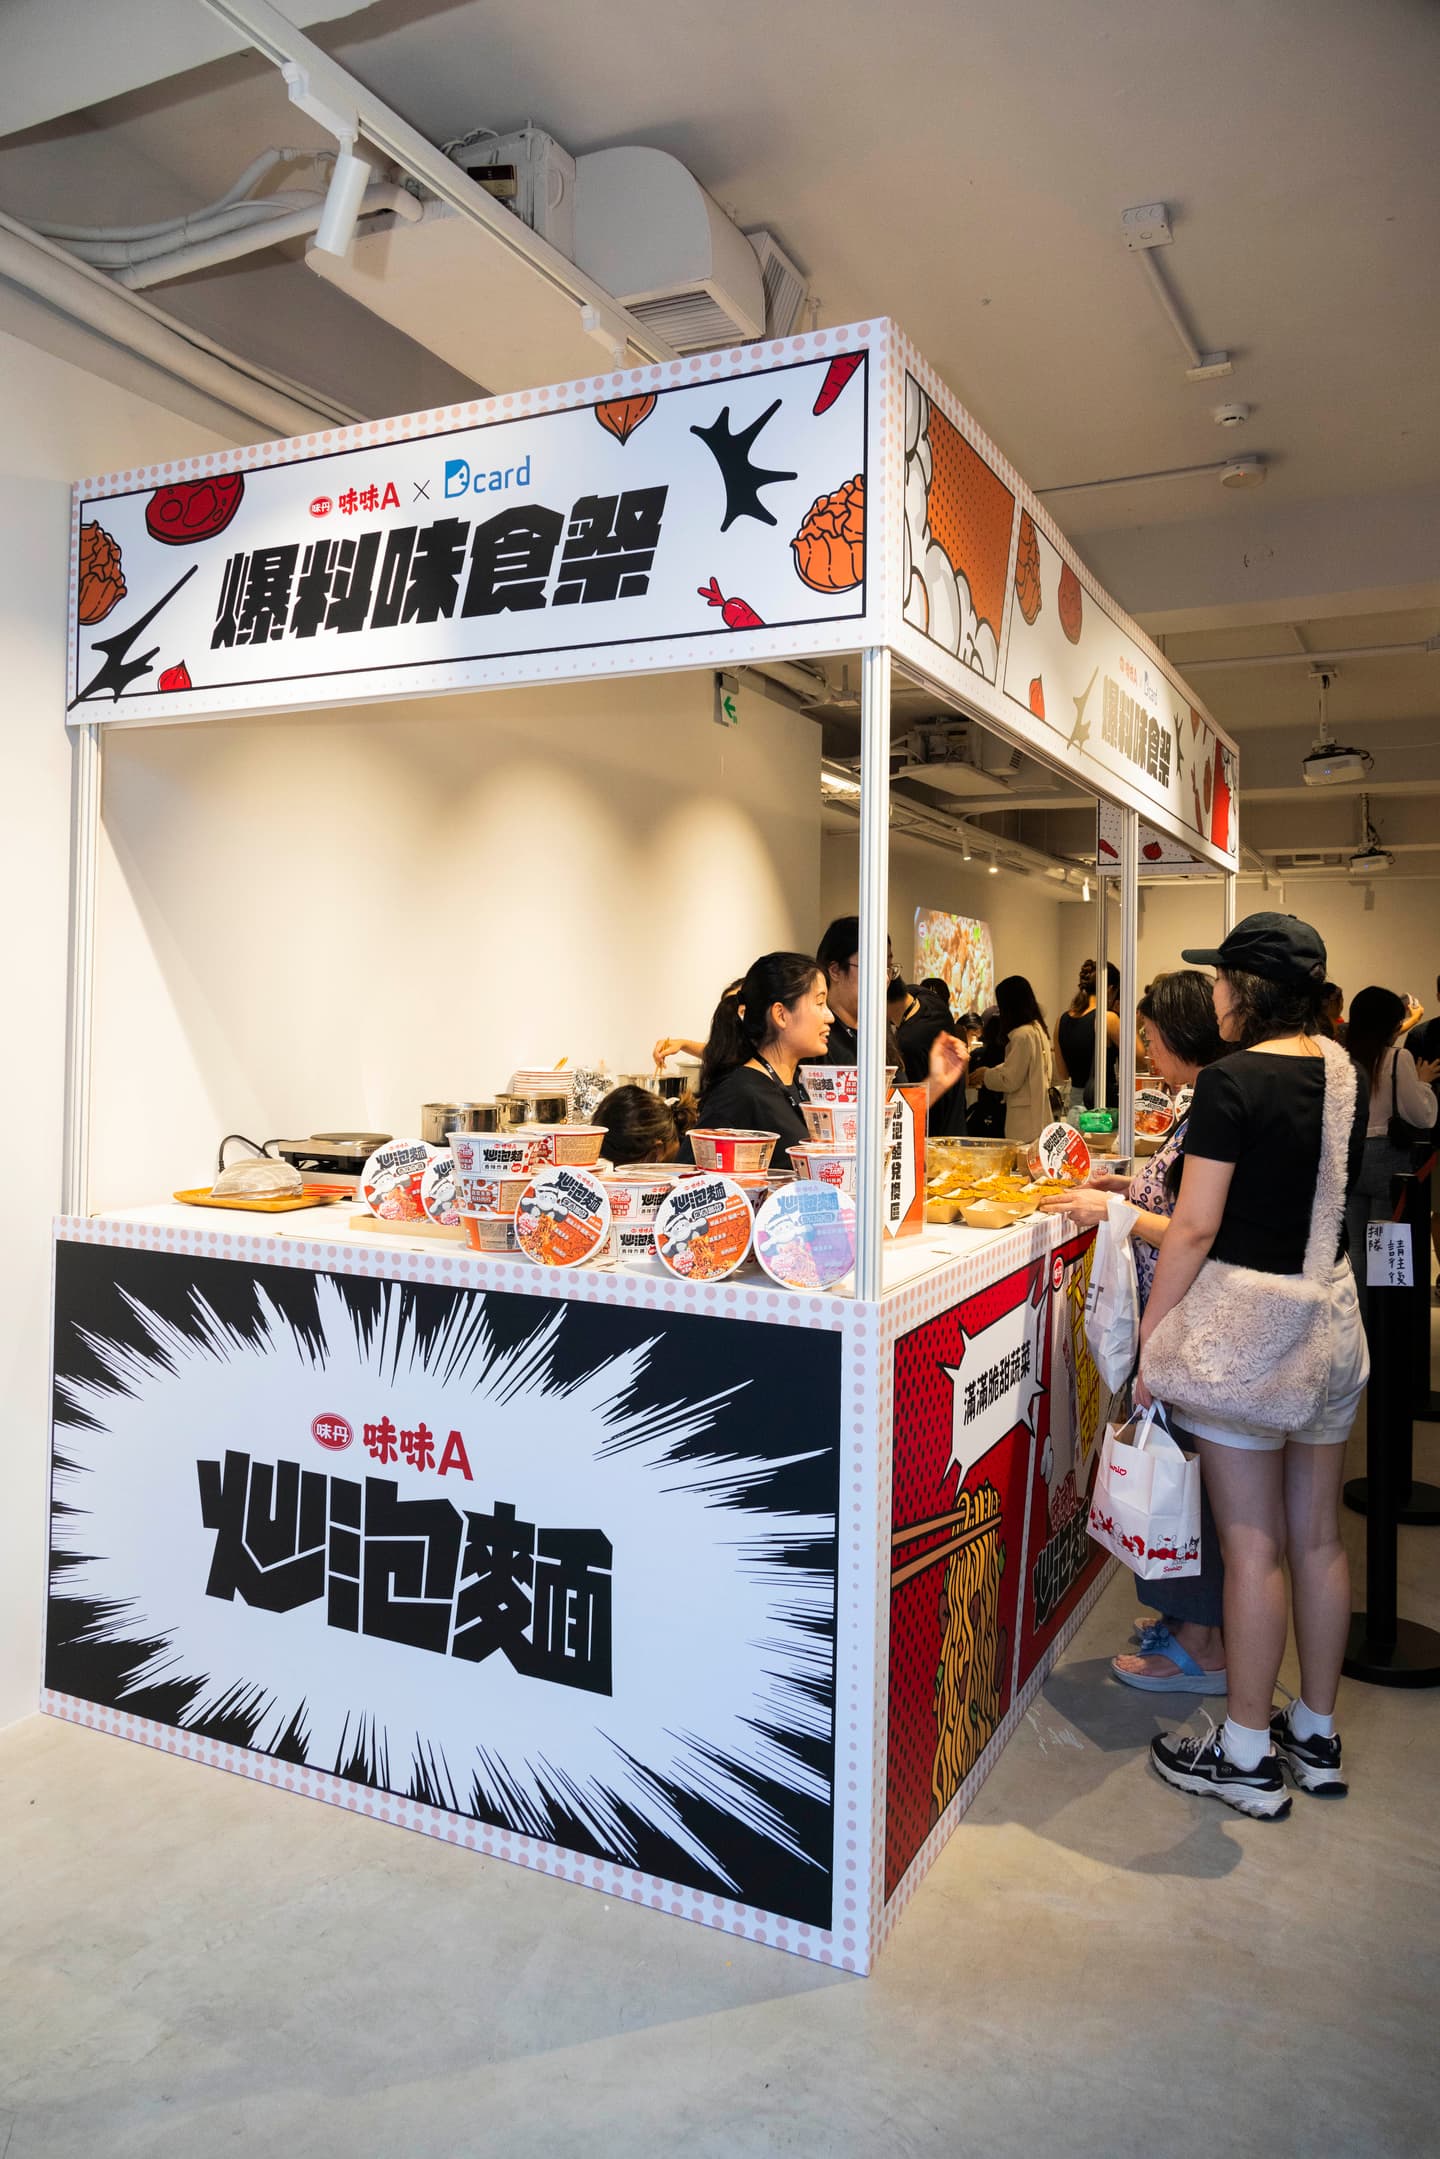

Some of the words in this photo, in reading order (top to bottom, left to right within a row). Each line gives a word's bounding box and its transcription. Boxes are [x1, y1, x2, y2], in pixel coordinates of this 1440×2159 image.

[338, 481, 401, 515] 味味A
[444, 455, 531, 499] Dcard
[209, 485, 670, 650] 爆料味食祭
[963, 1340, 1031, 1426] 滿滿脆甜蔬菜
[363, 1415, 474, 1481] 味味A
[197, 1450, 613, 1697] 炒泡麵
